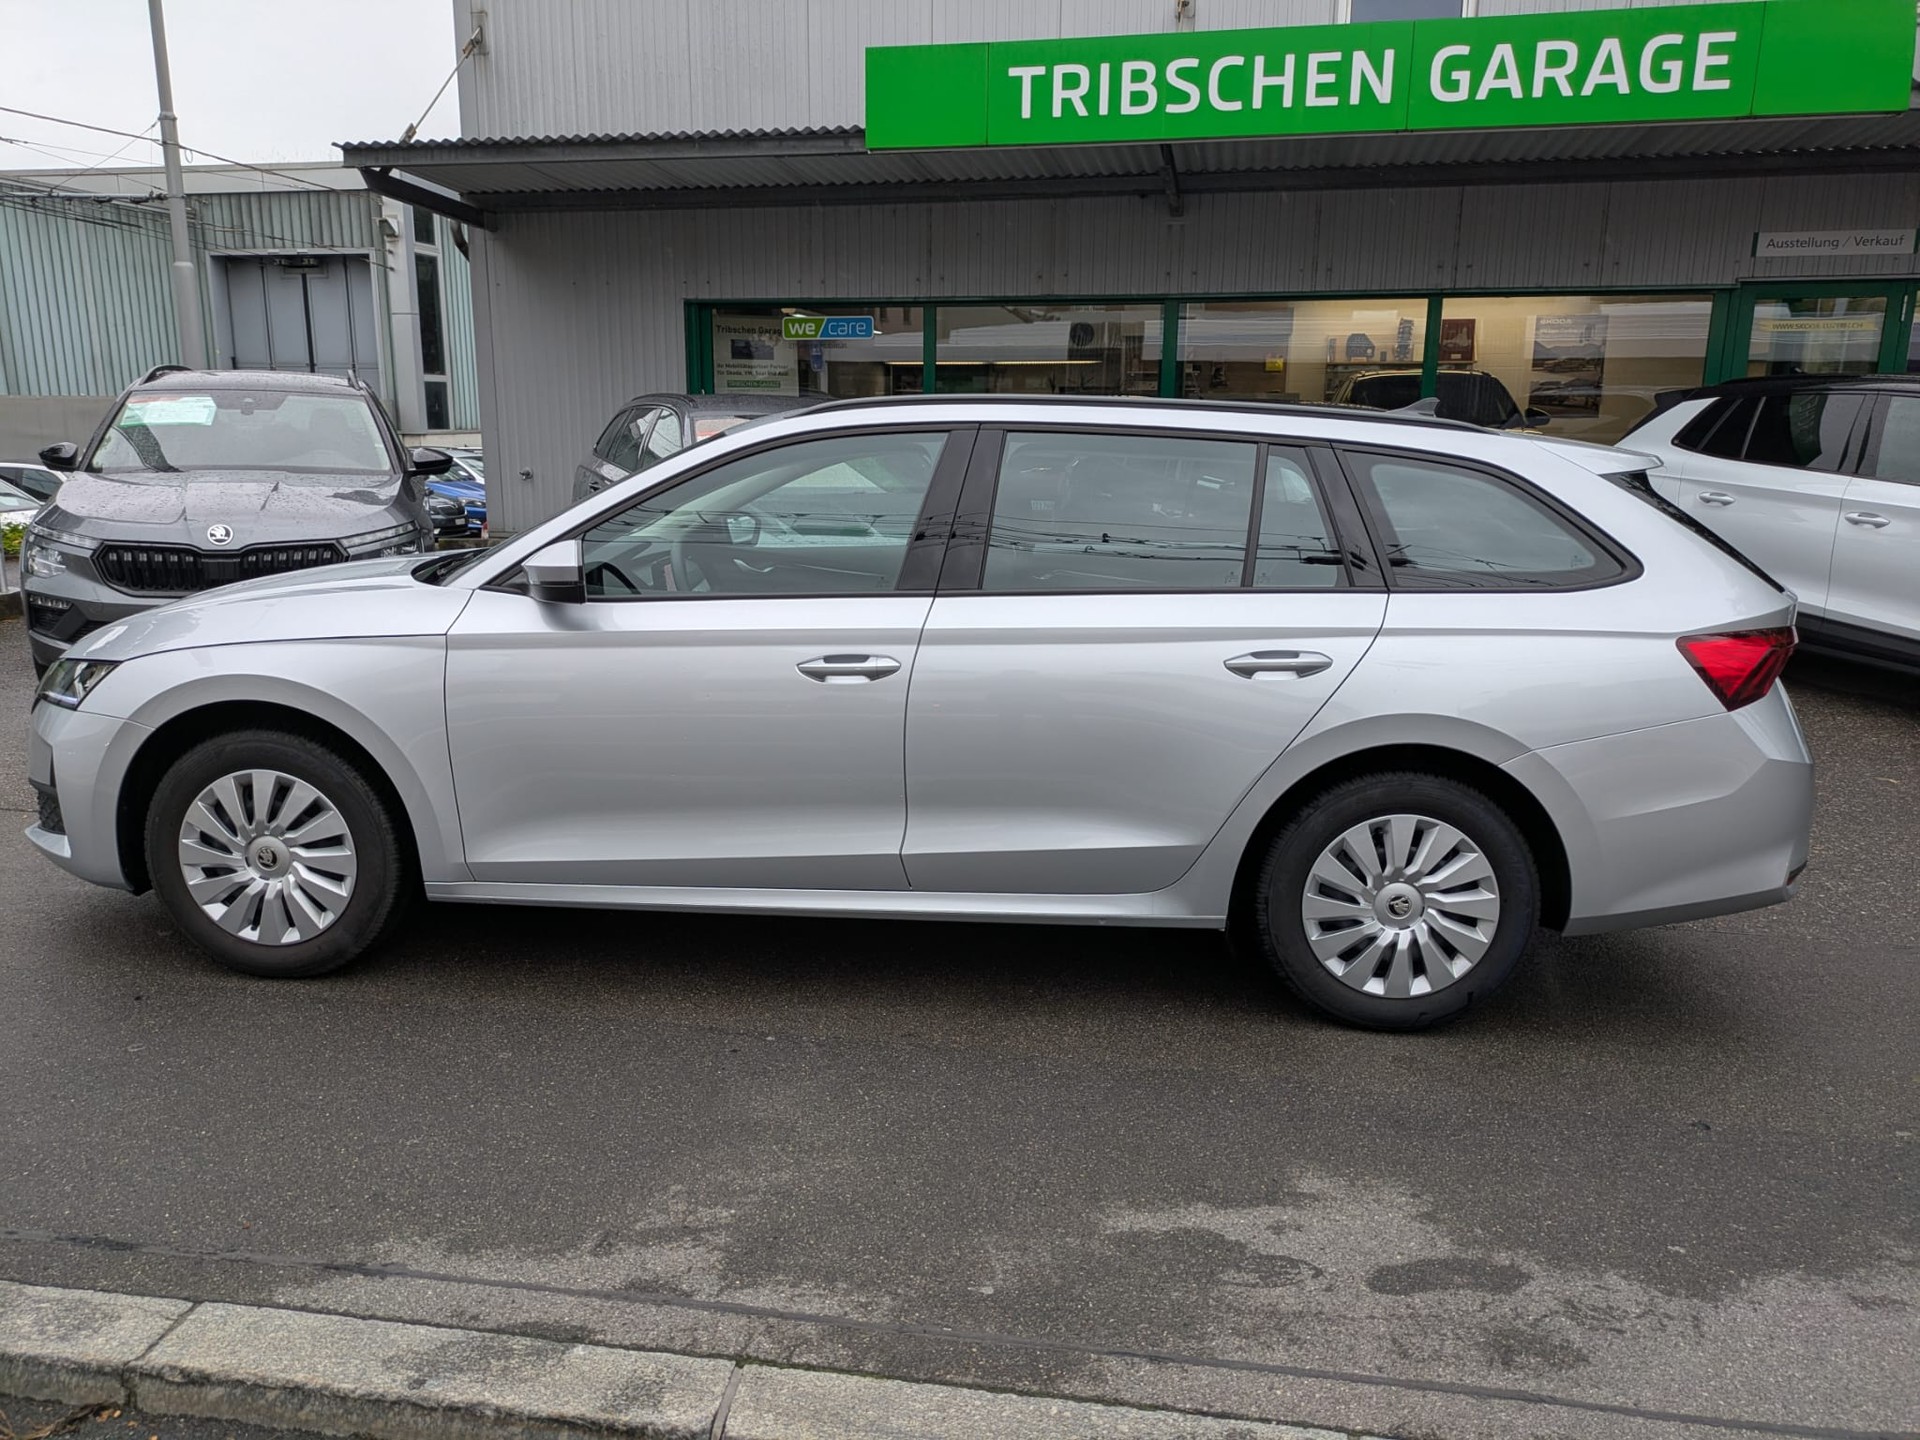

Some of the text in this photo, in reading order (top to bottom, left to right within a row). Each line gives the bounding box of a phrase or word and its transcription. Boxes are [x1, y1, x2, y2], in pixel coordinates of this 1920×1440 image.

[1008, 31, 1737, 119] TRIBSCHEN GARAGE
[1766, 237, 1840, 250] Ausstellung
[1854, 234, 1905, 247] Verkauf
[716, 324, 783, 337] Tribschen Garag
[788, 322, 867, 336] we care
